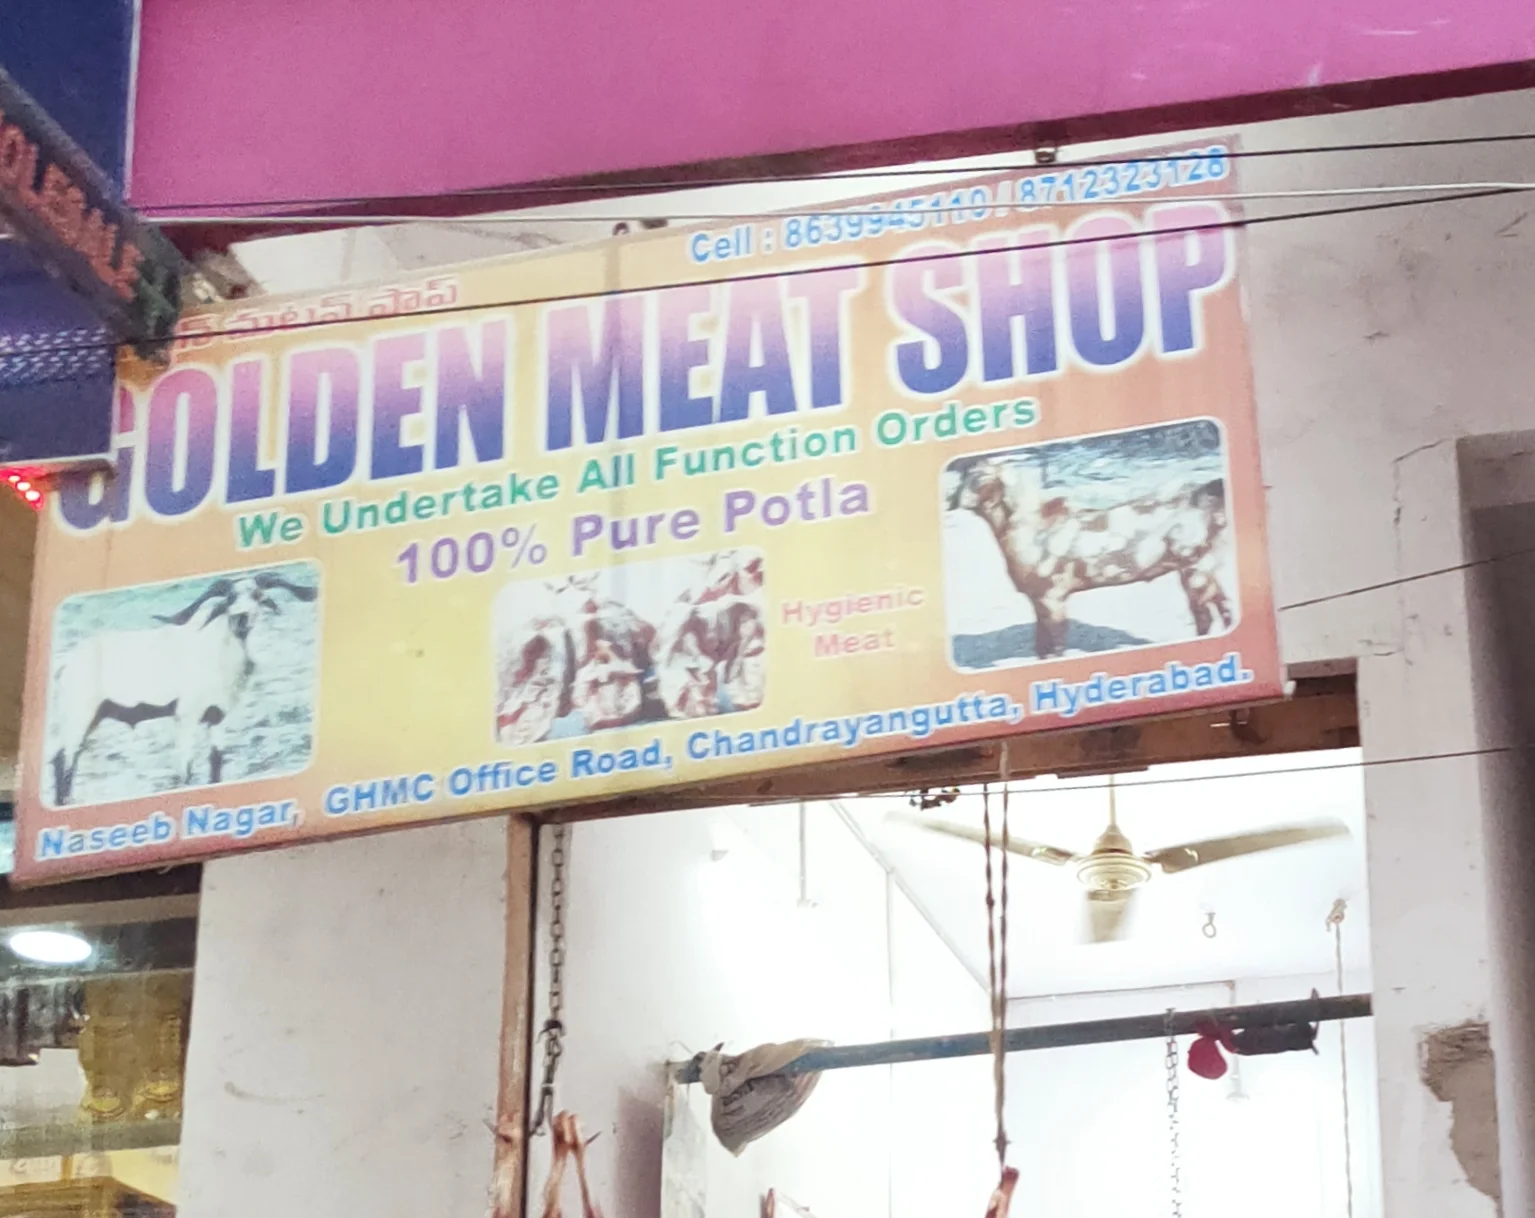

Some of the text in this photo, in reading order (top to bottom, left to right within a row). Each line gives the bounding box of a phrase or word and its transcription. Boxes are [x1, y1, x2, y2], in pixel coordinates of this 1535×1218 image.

[691, 226, 751, 262] Cell
[785, 188, 987, 248] 8639945110
[1021, 148, 1225, 203] 8712323128
[546, 270, 860, 452] MEAT
[895, 204, 1229, 395] SHOP
[239, 400, 1036, 548] We Undertake All Function Orders
[397, 477, 869, 584] 100% Pure Potla
[782, 587, 925, 627] Hygienic
[814, 627, 895, 657] Meat
[40, 654, 1252, 858] Naseeb Nagar, GHMC Office Road, Chandrayangutta, Hyderabad.
